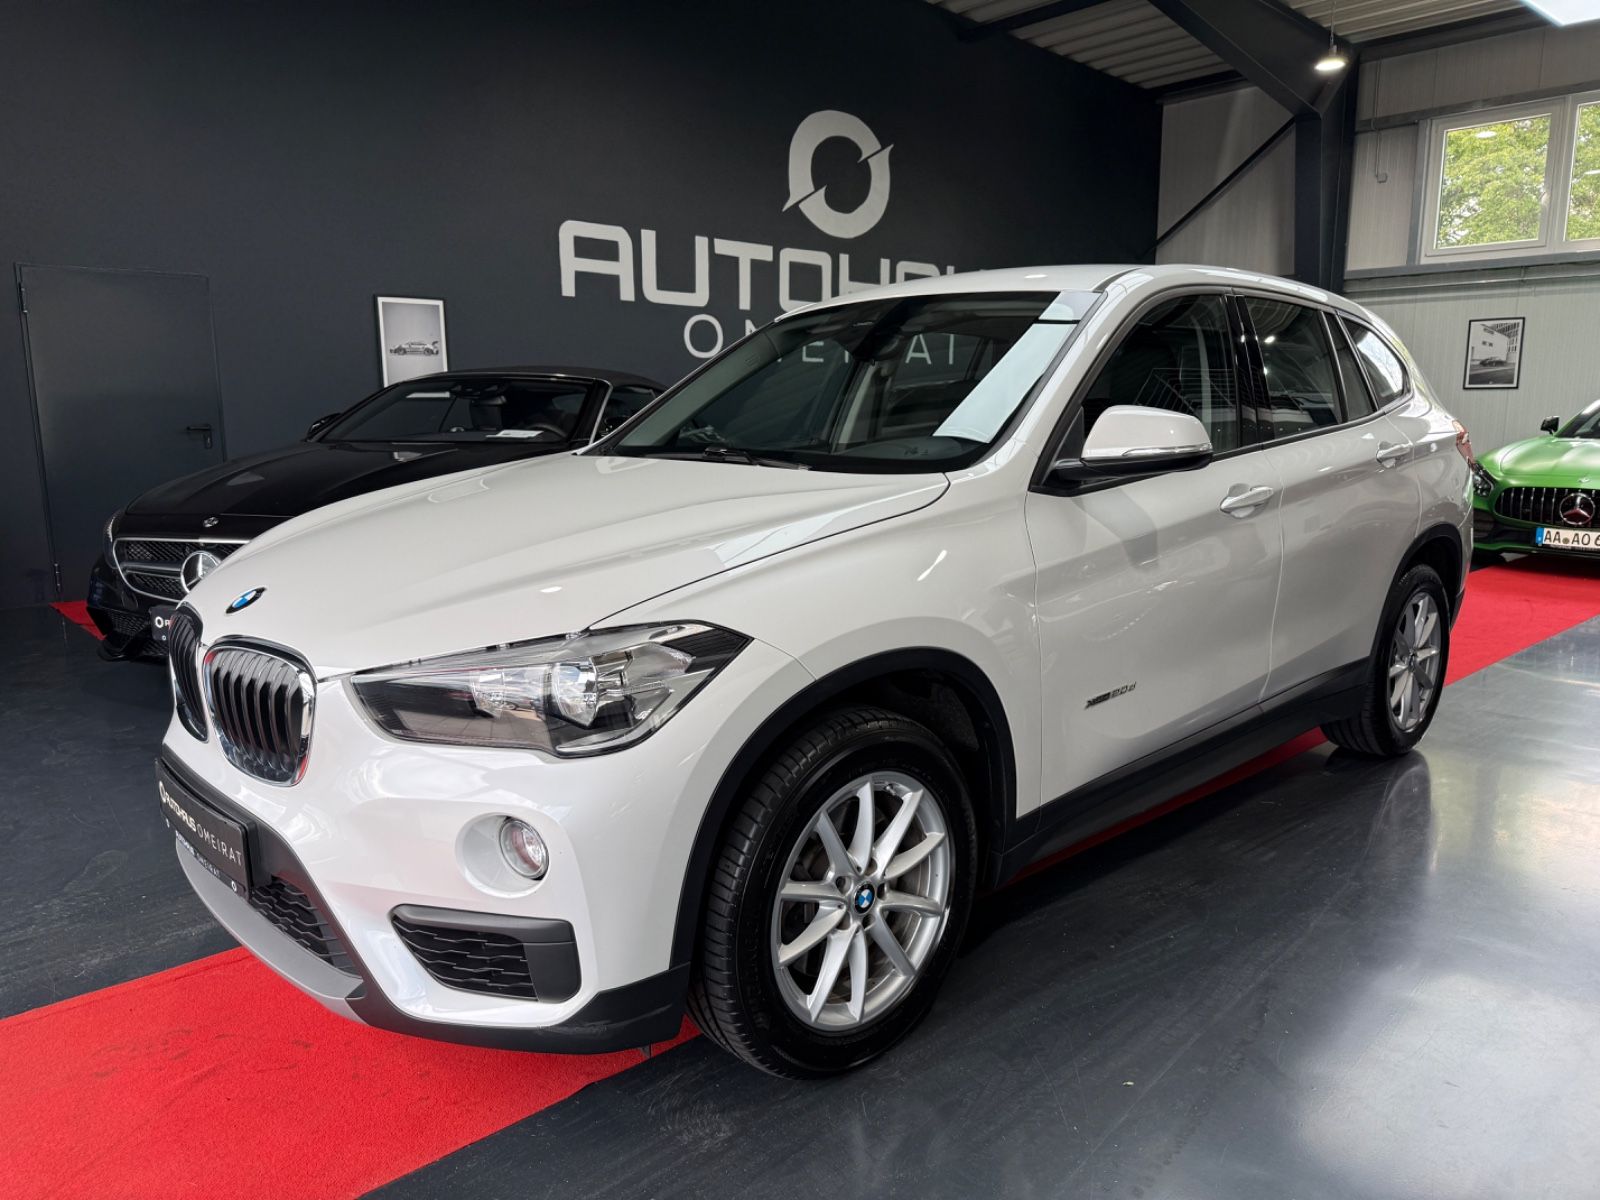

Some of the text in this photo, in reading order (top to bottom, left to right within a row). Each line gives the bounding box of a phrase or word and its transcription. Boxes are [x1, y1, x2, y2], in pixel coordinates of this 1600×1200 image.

[558, 219, 986, 313] AUTOH
[1543, 529, 1561, 544] AA
[1571, 532, 1591, 546] AO
[197, 823, 242, 867] OMEIRAT
